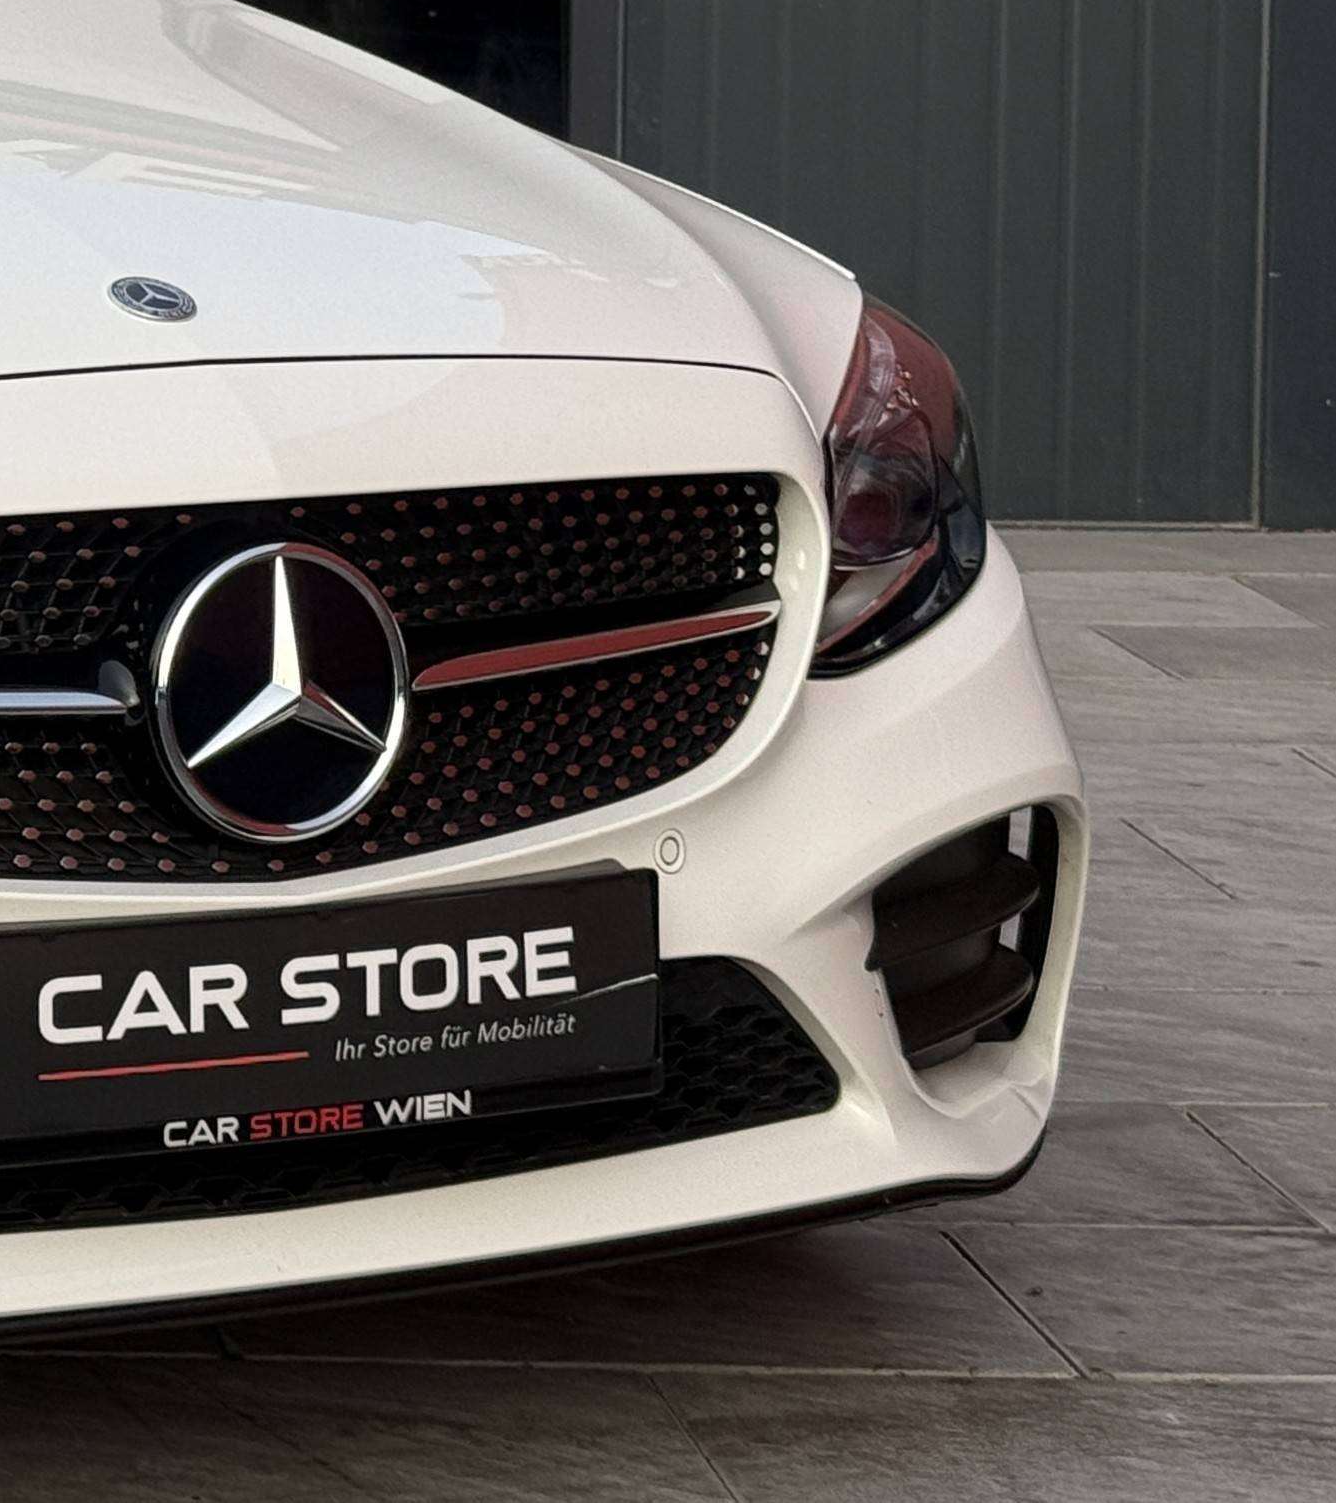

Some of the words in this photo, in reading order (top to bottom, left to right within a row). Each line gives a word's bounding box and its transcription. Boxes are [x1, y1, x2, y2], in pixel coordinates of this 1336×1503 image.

[38, 963, 249, 1045] CAR
[280, 926, 578, 1024] STORE
[335, 1038, 367, 1063] Ihr
[373, 1033, 434, 1058] Store
[440, 1025, 472, 1051] für
[478, 1013, 578, 1044] Mobilität
[163, 1117, 240, 1148] CAR
[249, 1103, 365, 1140] STORE
[374, 1090, 473, 1126] WIEN
